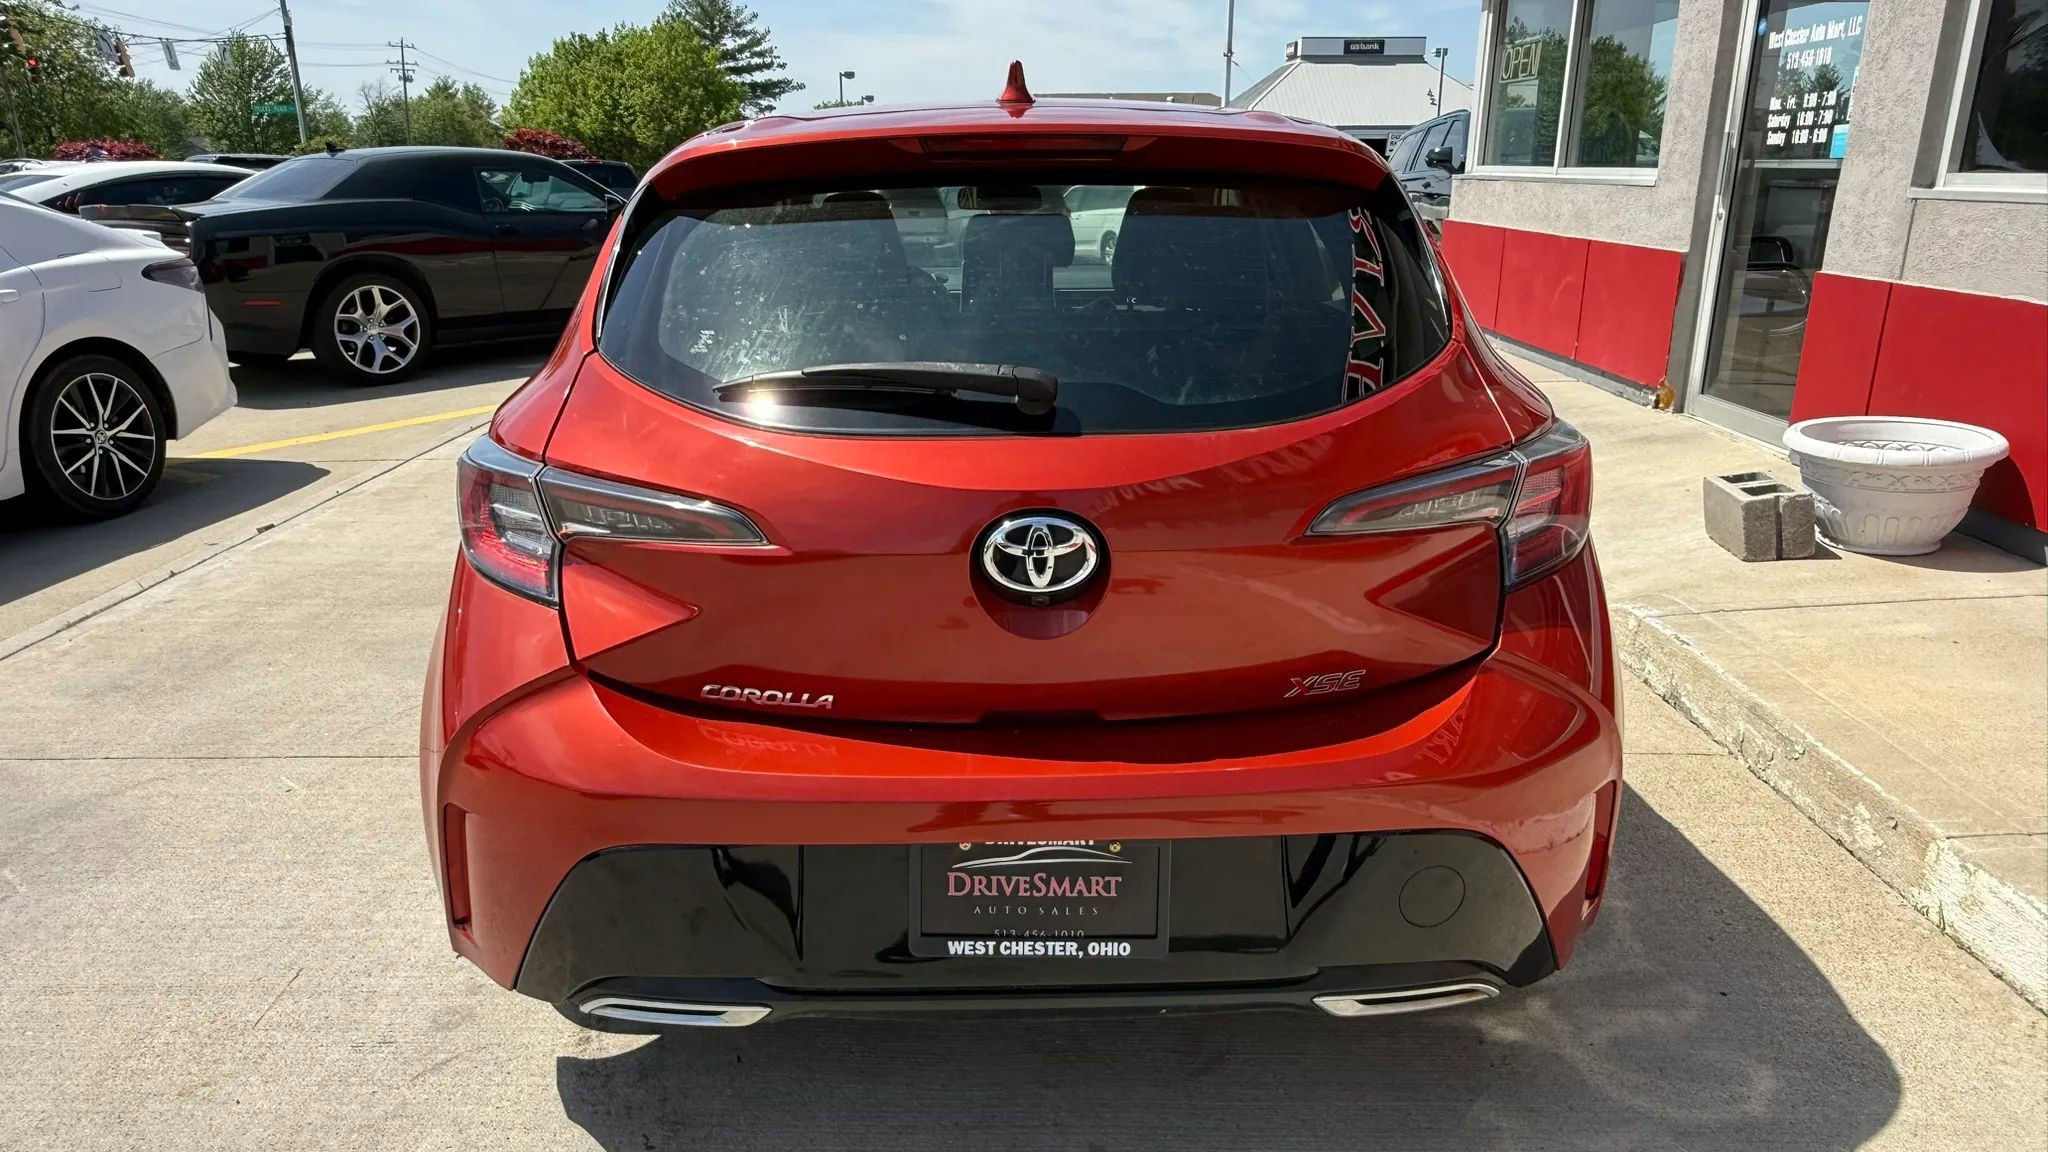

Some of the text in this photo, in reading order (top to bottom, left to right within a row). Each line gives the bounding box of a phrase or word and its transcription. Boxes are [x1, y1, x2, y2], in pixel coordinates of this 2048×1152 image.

[1848, 15, 1863, 37] LLC
[1502, 43, 1540, 80] OPEN
[1283, 669, 1367, 698] XSE
[700, 684, 834, 709] COROLLA
[973, 905, 1099, 916] AUTO SALES
[947, 941, 1131, 959] WEST CHESTER, OHIO
